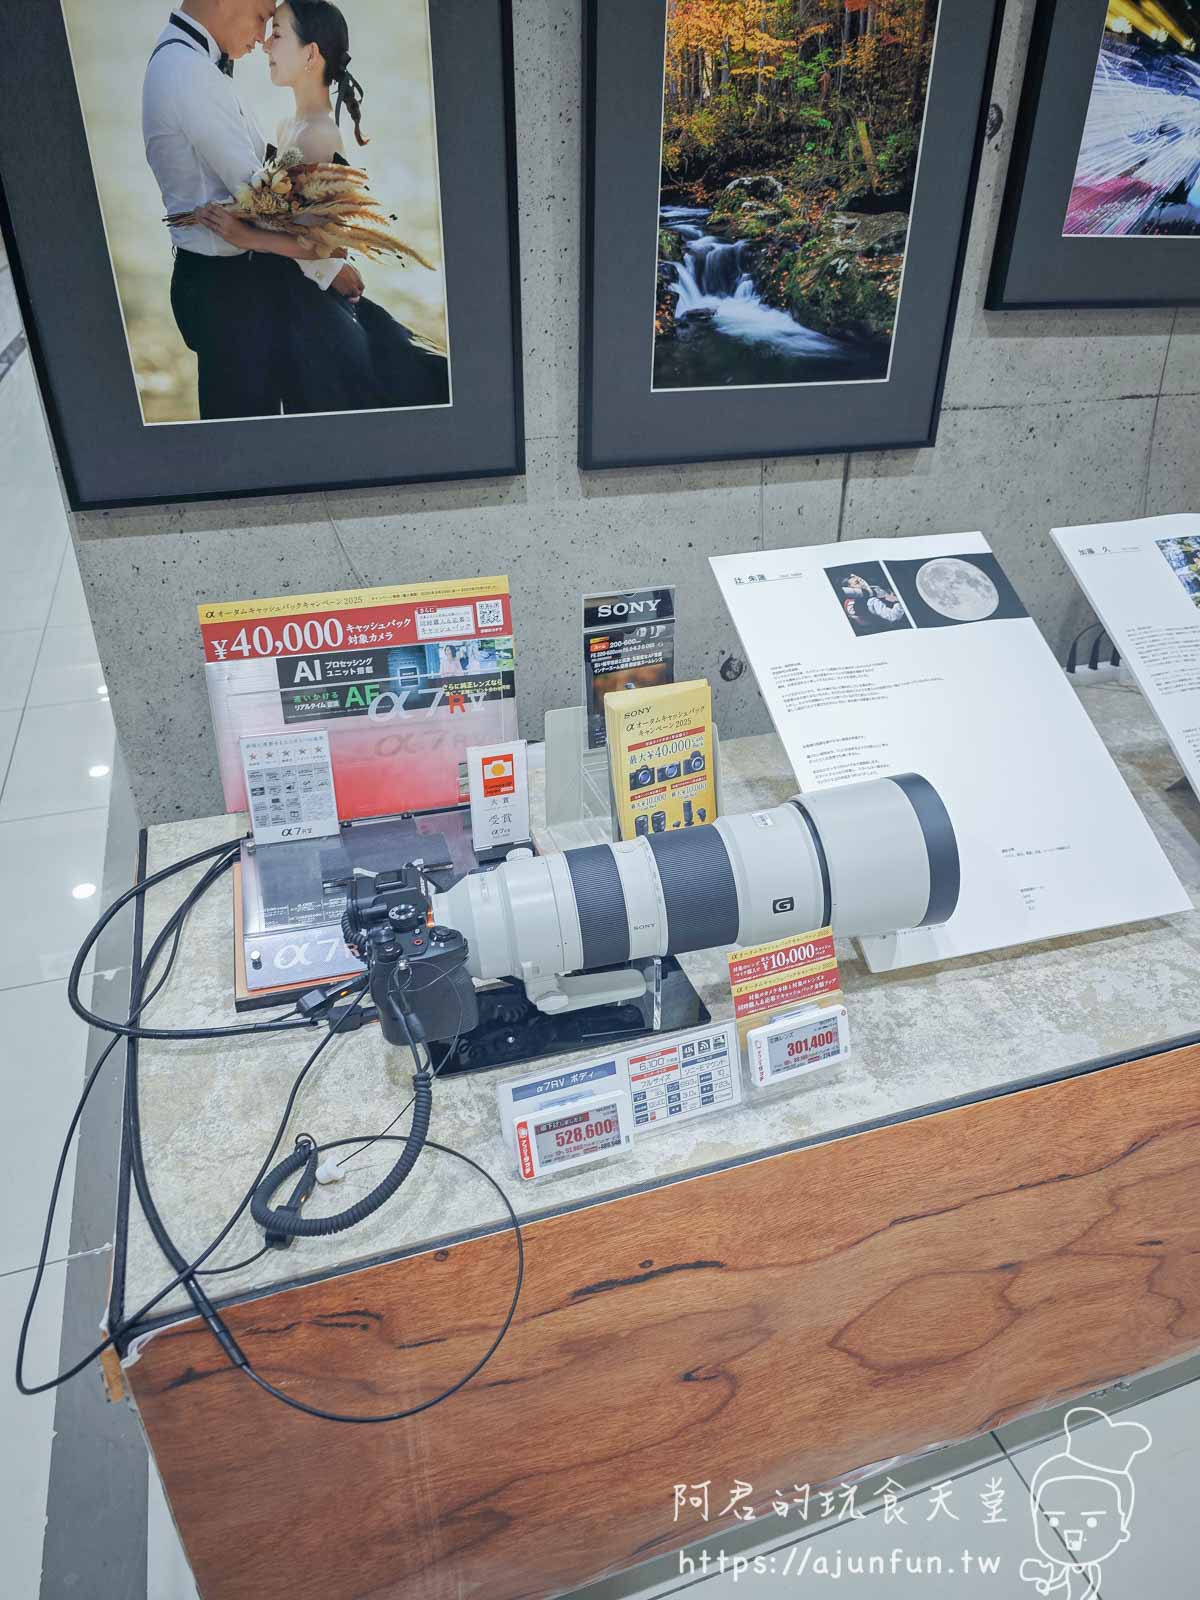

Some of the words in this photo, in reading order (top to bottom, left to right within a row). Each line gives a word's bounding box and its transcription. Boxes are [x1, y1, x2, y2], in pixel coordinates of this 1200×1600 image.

[597, 599, 662, 618] SONY
[346, 618, 411, 633] キャッシュバック
[211, 618, 344, 660] ¥40,000
[347, 632, 394, 646] 対象カメラ
[294, 659, 322, 683] AI
[325, 657, 373, 669] プロセッシング
[345, 684, 380, 708] AF
[624, 706, 652, 719] SONY
[633, 923, 657, 932] SONY
[762, 943, 815, 971] ¥10,000
[787, 1030, 833, 1057] 301,400
[640, 1057, 665, 1071] 6,100
[570, 1070, 595, 1084] ボディ
[555, 1119, 613, 1147] 528,600
